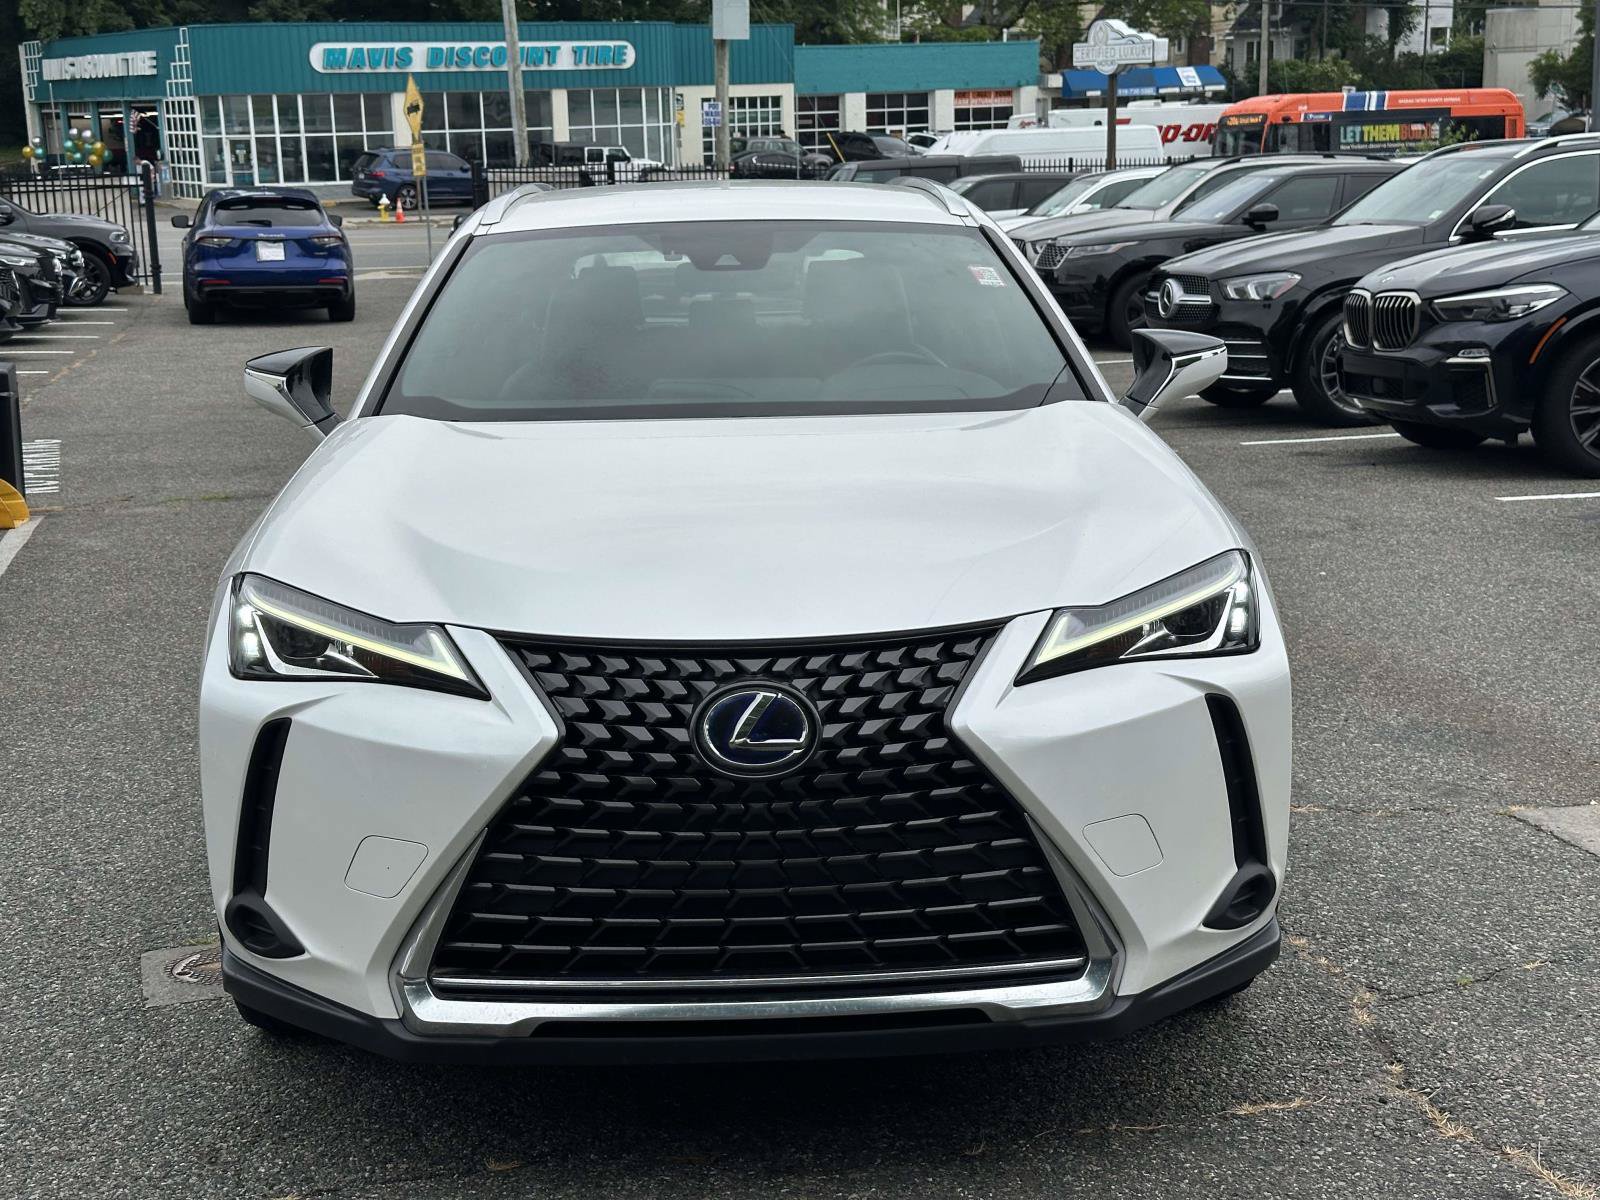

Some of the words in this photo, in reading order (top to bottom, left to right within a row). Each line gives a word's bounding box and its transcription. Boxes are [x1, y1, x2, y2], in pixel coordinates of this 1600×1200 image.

[323, 46, 413, 70] MAVIS
[572, 44, 628, 67] TIRE
[1340, 125, 1361, 143] LET
[1362, 123, 1400, 142] THEM
